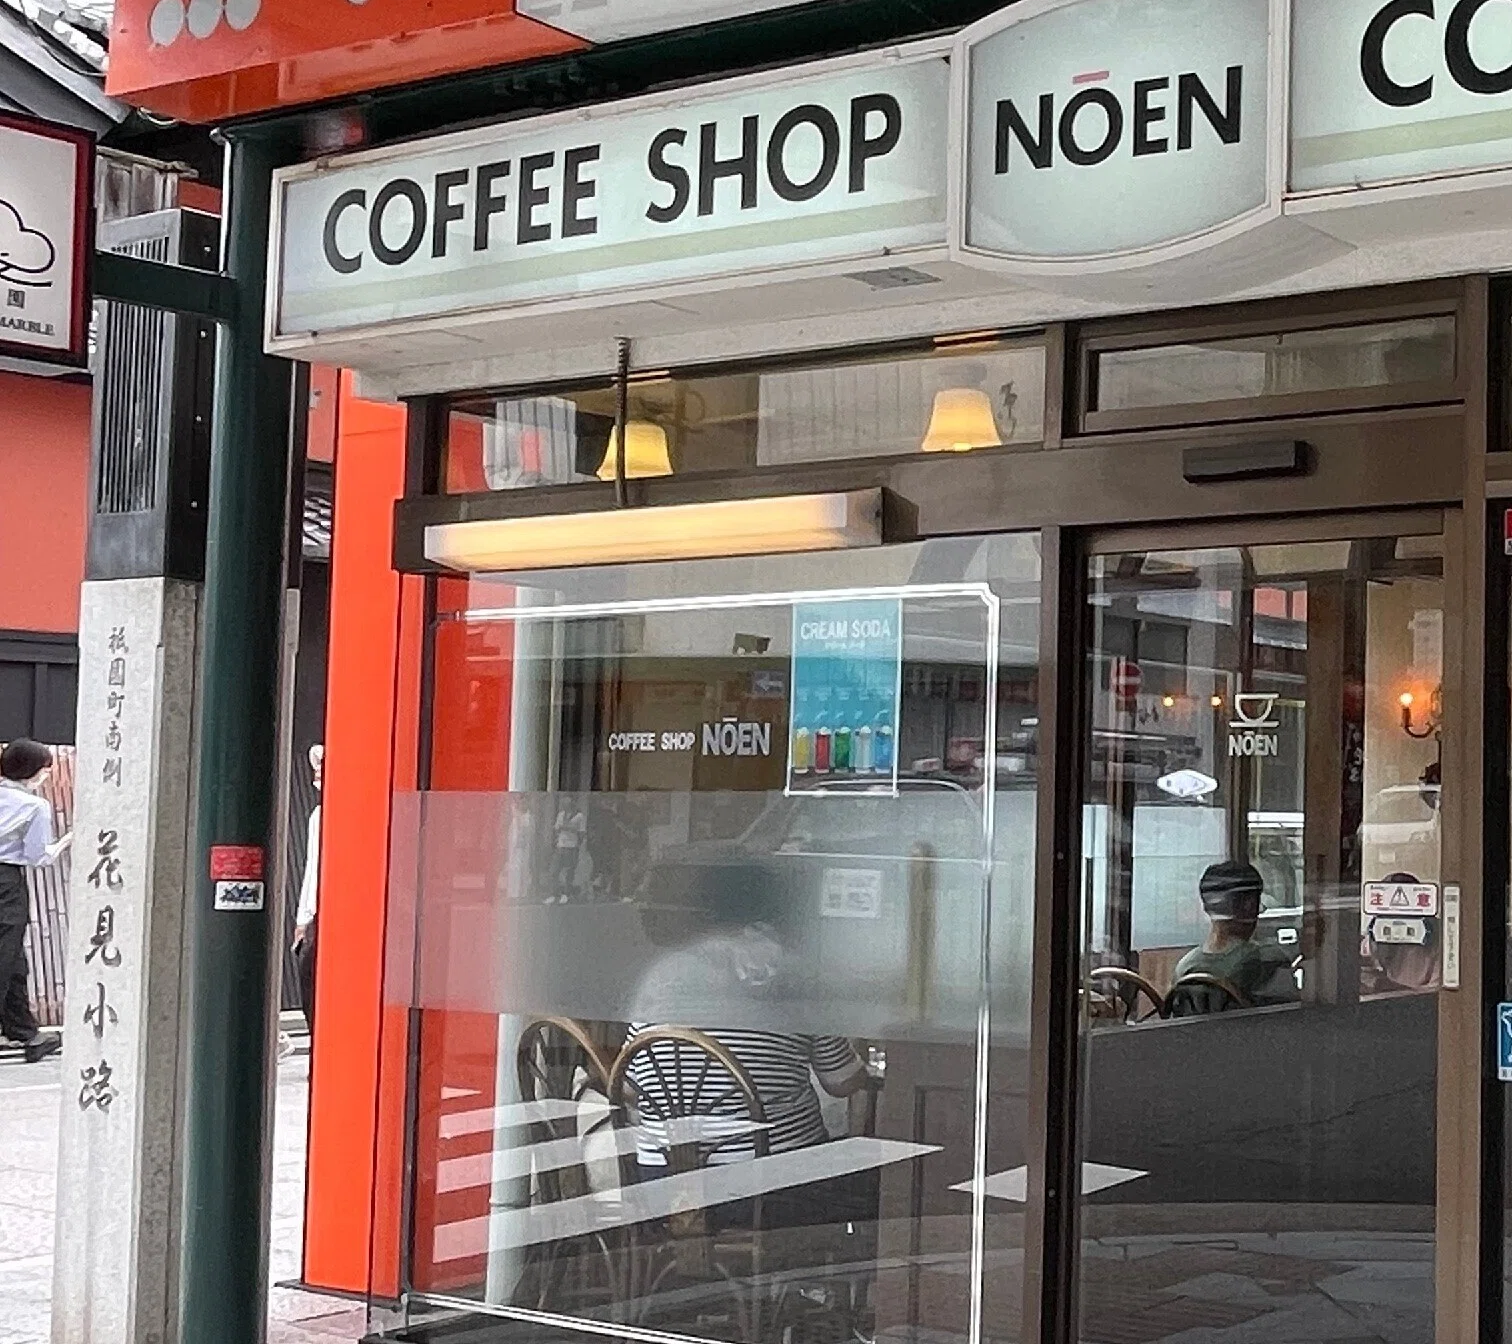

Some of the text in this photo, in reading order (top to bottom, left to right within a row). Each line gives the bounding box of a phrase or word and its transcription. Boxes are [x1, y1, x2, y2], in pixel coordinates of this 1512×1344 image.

[995, 65, 1243, 175] NŌEN
[323, 93, 901, 273] COFFEE SHOP
[800, 619, 892, 640] CREAM SODA
[608, 716, 771, 756] COFFEE SHOP NŌEN
[1228, 730, 1278, 757] NŌEN
[77, 828, 127, 1116] 花見小路
